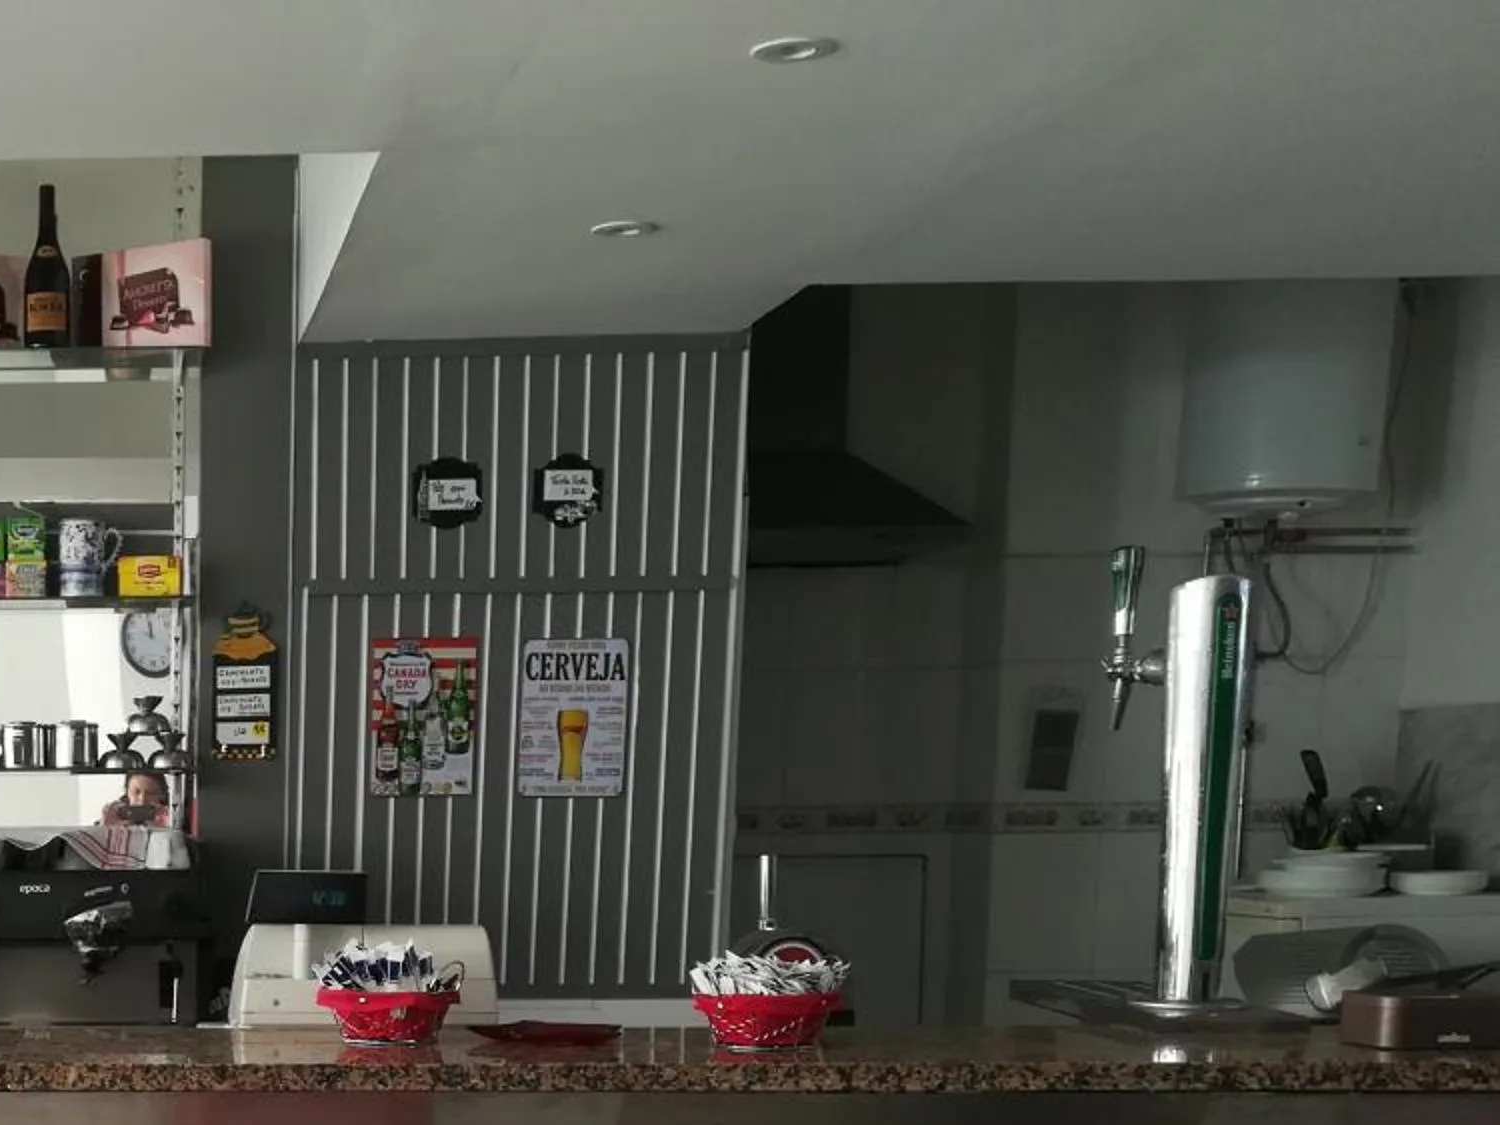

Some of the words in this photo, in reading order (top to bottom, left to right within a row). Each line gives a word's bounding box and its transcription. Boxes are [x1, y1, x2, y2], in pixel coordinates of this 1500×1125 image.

[525, 652, 625, 681] CERVEJA
[387, 667, 427, 678] CANADA
[395, 679, 418, 689] DRY
[19, 884, 51, 895] epoca
